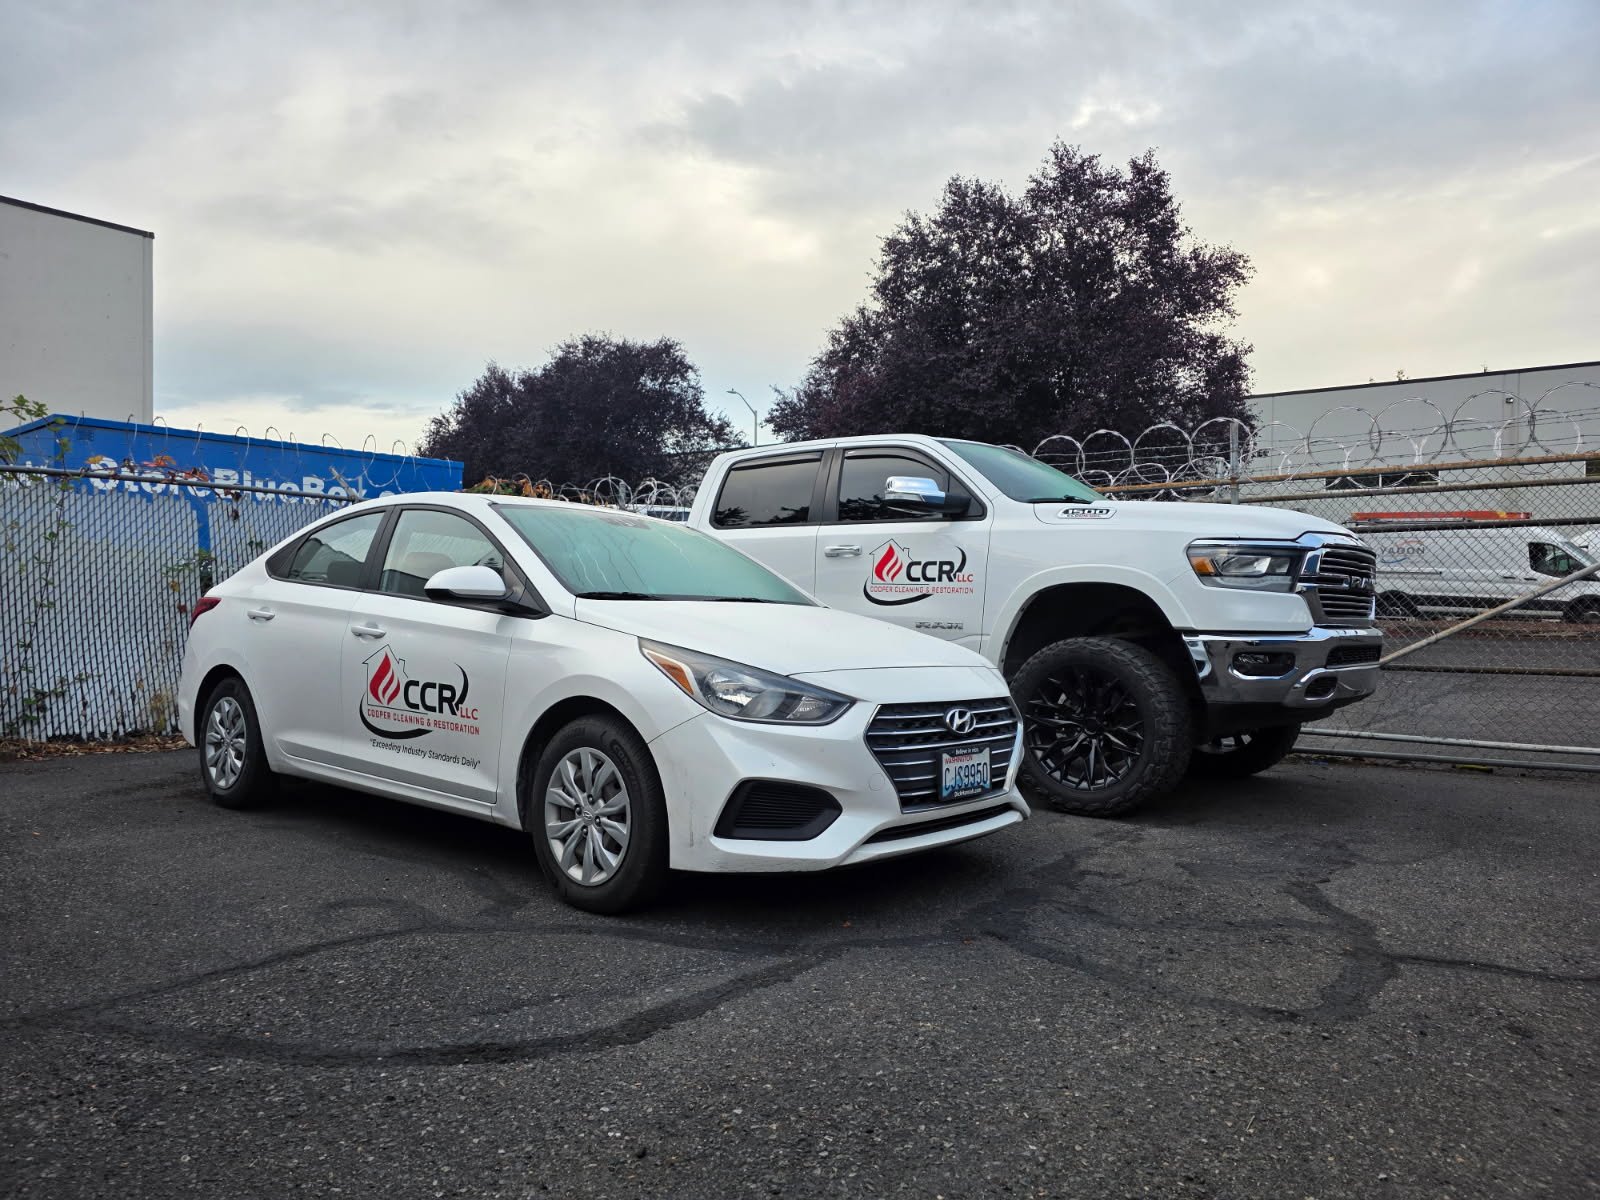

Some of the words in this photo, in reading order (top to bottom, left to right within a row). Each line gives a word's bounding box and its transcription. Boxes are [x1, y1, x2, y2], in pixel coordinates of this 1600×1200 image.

[906, 560, 955, 582] CCR
[957, 574, 974, 583] LLC
[869, 585, 893, 593] COOPER
[894, 585, 924, 594] CLEANING
[931, 586, 974, 595] RESTORATION
[404, 679, 457, 716] CCR
[460, 708, 479, 720] LLC
[367, 708, 391, 720] COOPER
[393, 712, 425, 726] CLEANING
[426, 718, 431, 727] &
[433, 719, 480, 735] RESTORATION
[402, 744, 428, 759] Industry
[428, 749, 460, 764] Standards
[944, 762, 989, 791] CJS9950
